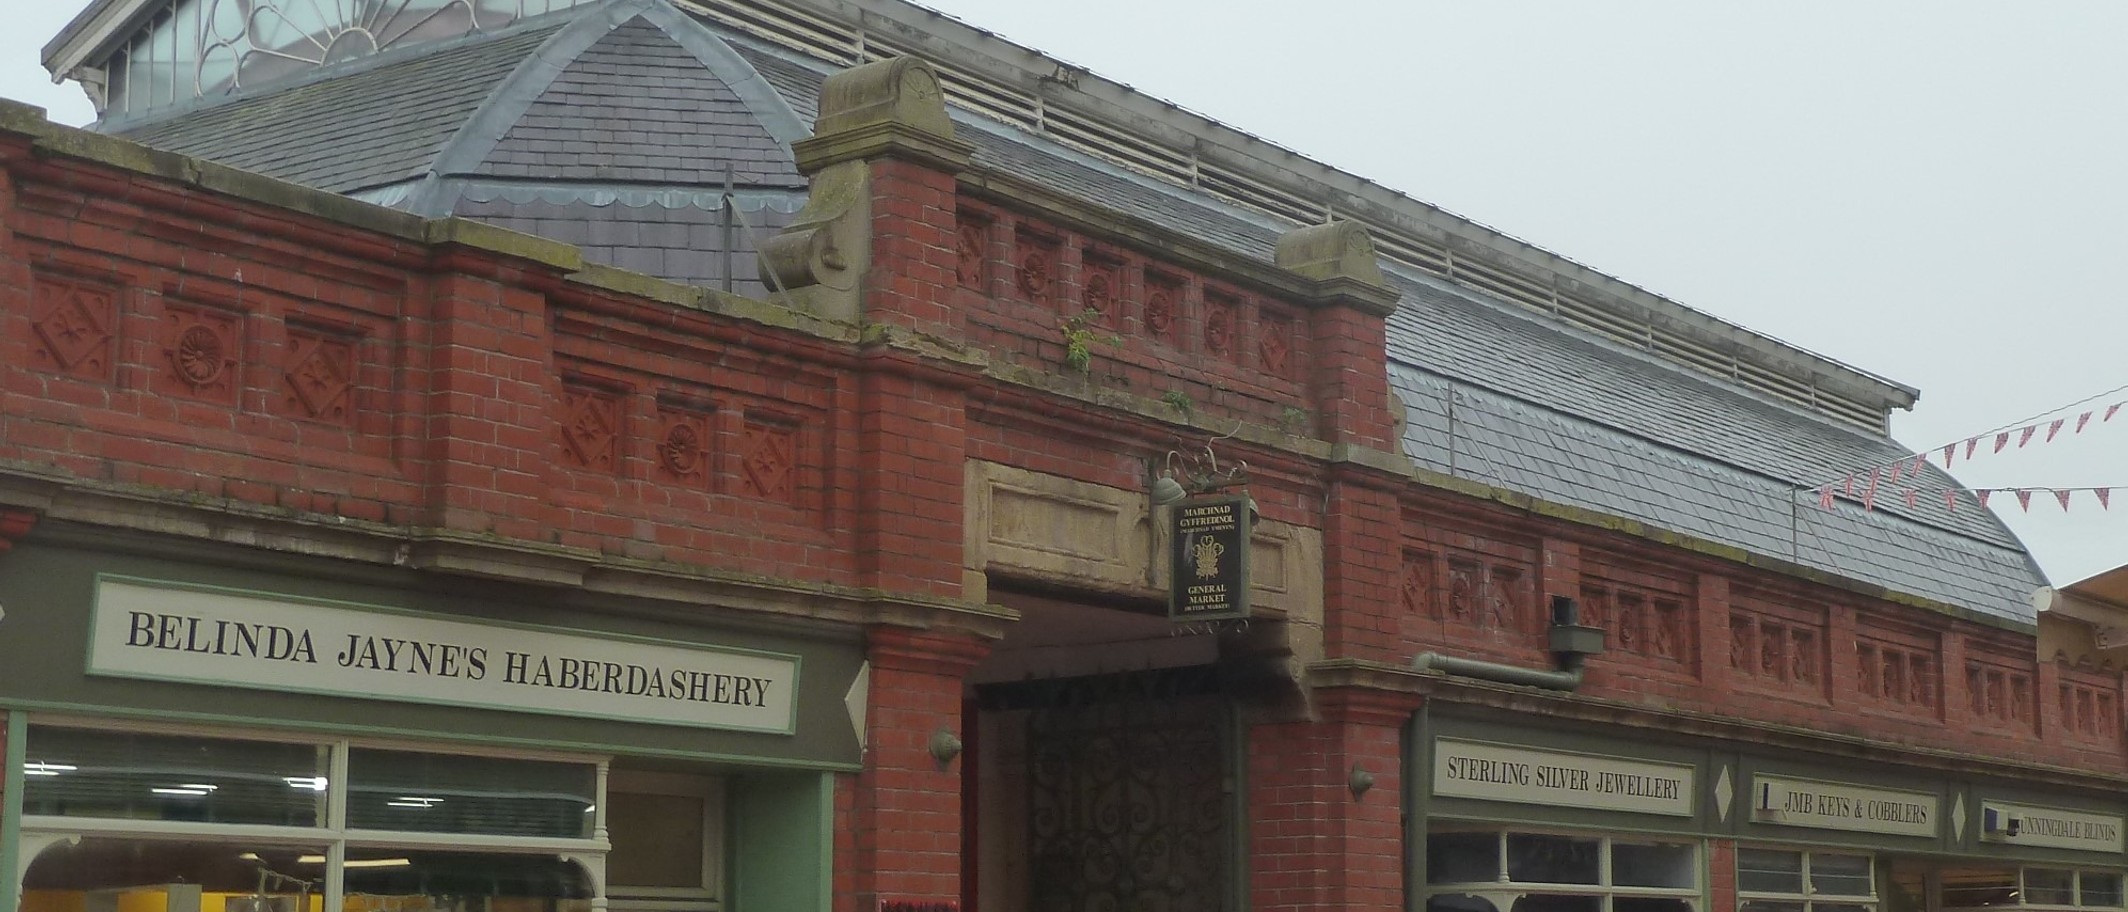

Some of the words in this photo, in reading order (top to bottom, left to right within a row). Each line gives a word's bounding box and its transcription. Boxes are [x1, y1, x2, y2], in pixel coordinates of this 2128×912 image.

[1184, 505, 1230, 517] MARCHNAD
[1180, 515, 1235, 527] GYFFREDINOL
[1188, 584, 1227, 595] GENERAL
[1189, 594, 1226, 604] MARKET
[125, 610, 318, 663] BELINDA
[337, 634, 488, 681] JAYNE'S
[502, 651, 773, 707] HABERDASHERY
[1447, 756, 1530, 786] STERLING
[1536, 765, 1590, 791] SILVER
[1596, 771, 1681, 800] JEWELLERY
[1784, 791, 1813, 815] JMB
[1818, 794, 1850, 818] KEYS
[1854, 799, 1863, 819] &
[1868, 800, 1928, 825] COBBLERS
[2017, 816, 2081, 838] UNNINGDALE
[2083, 822, 2117, 841] BLINDS
